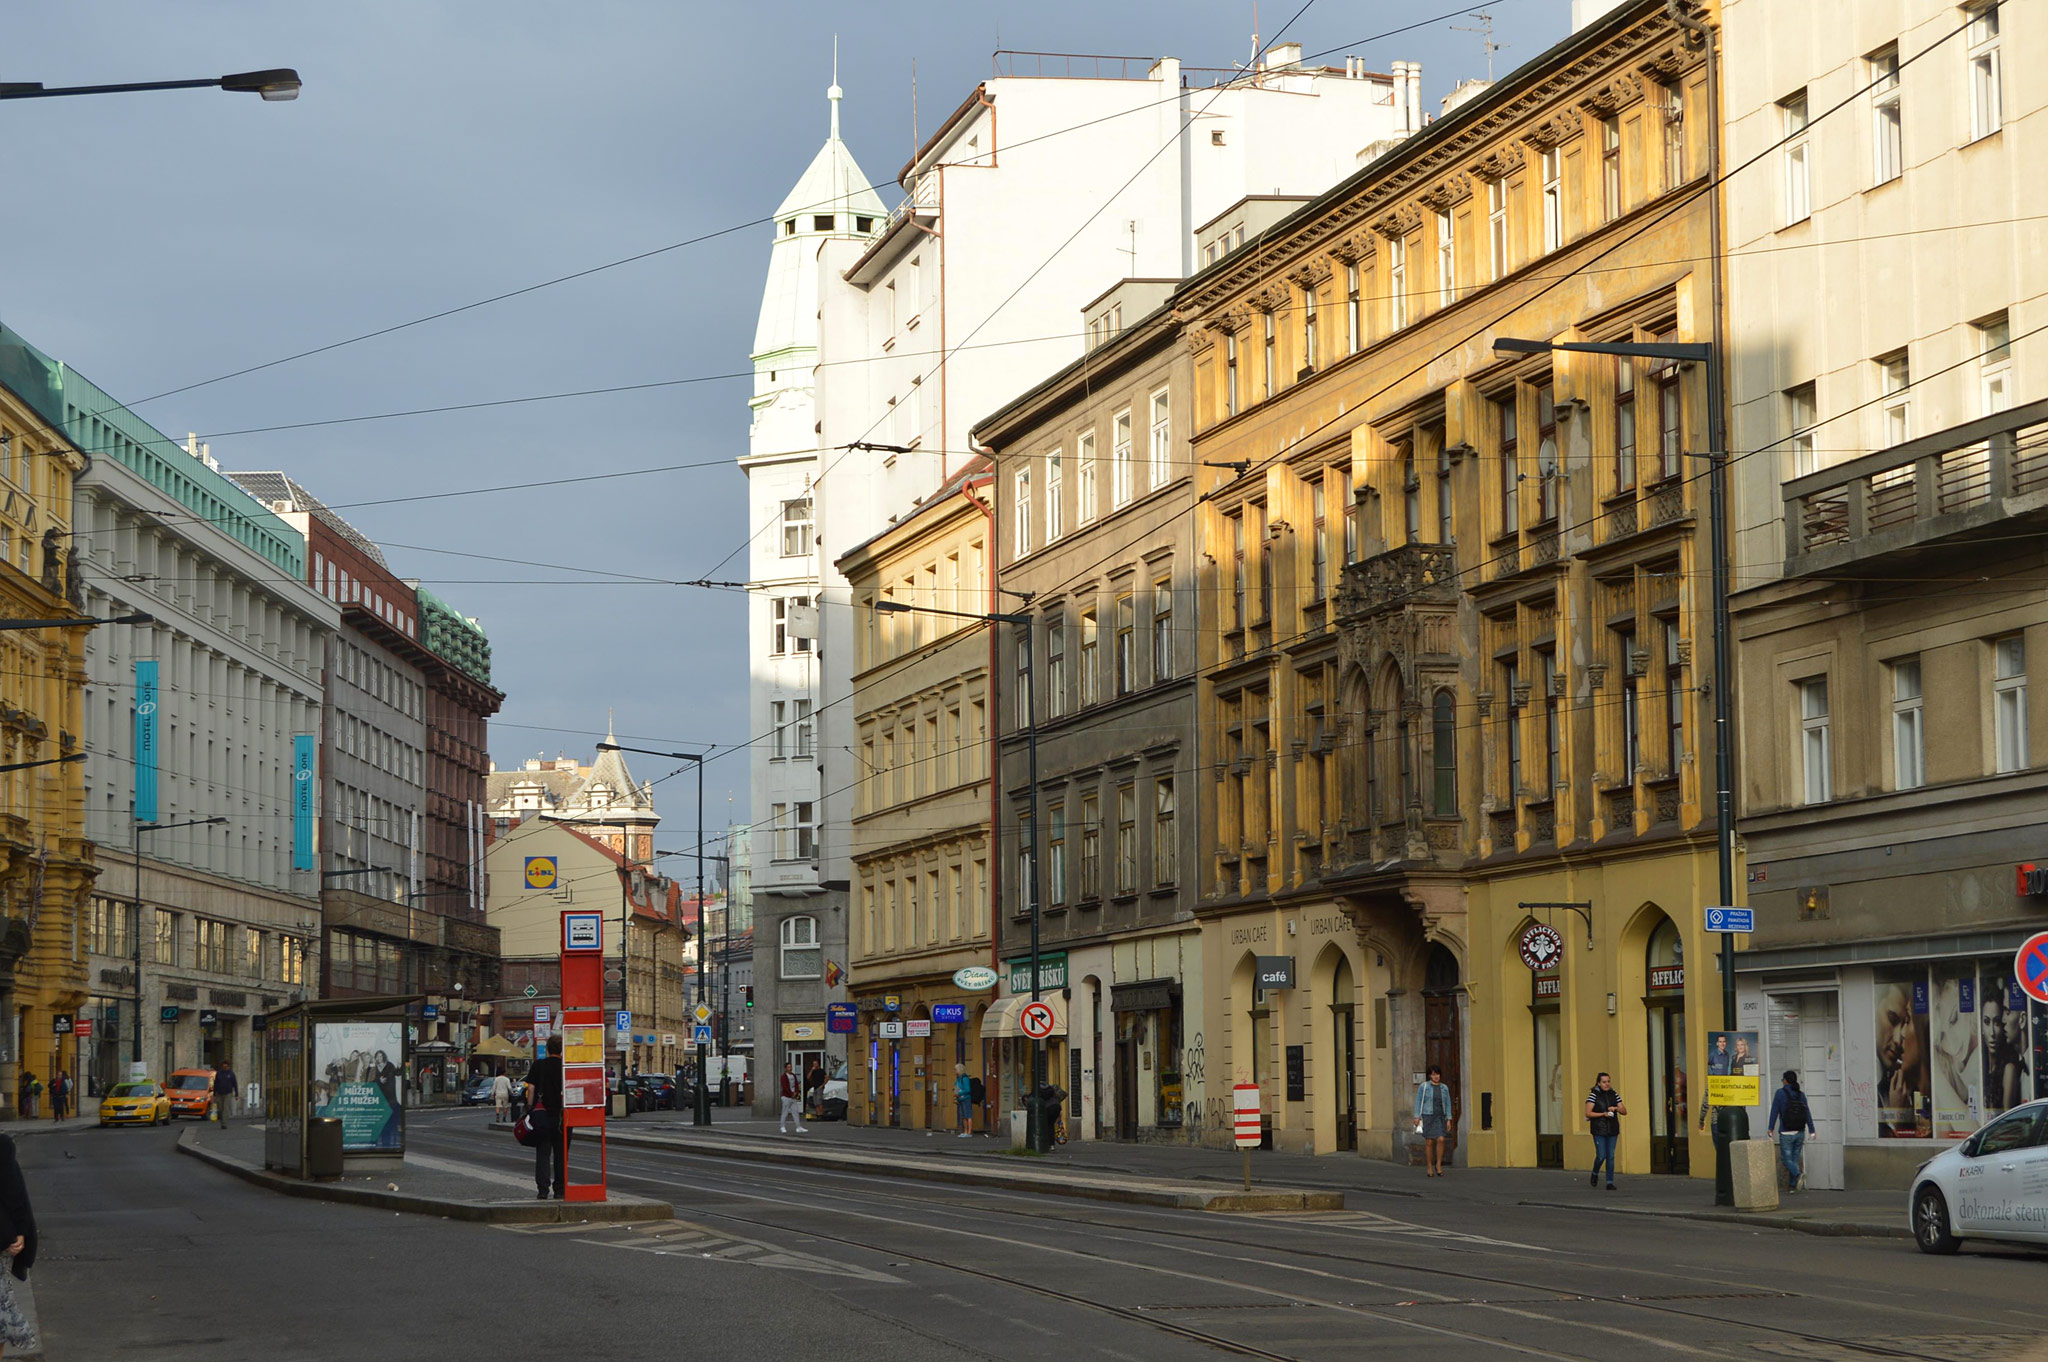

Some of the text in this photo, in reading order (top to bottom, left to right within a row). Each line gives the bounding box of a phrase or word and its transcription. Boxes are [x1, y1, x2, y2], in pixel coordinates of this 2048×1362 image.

[143, 681, 151, 751] MOTEL ONE
[1231, 921, 1268, 945] URBAN CAFÉ
[1311, 918, 1333, 935] URBAN
[1523, 926, 1562, 947] AFFLICTION
[1524, 953, 1541, 968] LIVE
[1541, 955, 1560, 970] FAST
[963, 969, 989, 979] Diana
[1012, 963, 1065, 991] SVĚT ŘÍŠKŮ
[1262, 970, 1287, 982] café
[619, 1013, 628, 1025] P
[935, 1007, 962, 1016] FOKUS
[344, 1085, 374, 1095] MŮŽEM
[343, 1096, 349, 1105] S
[1959, 1197, 2048, 1230] dokonalé steny
